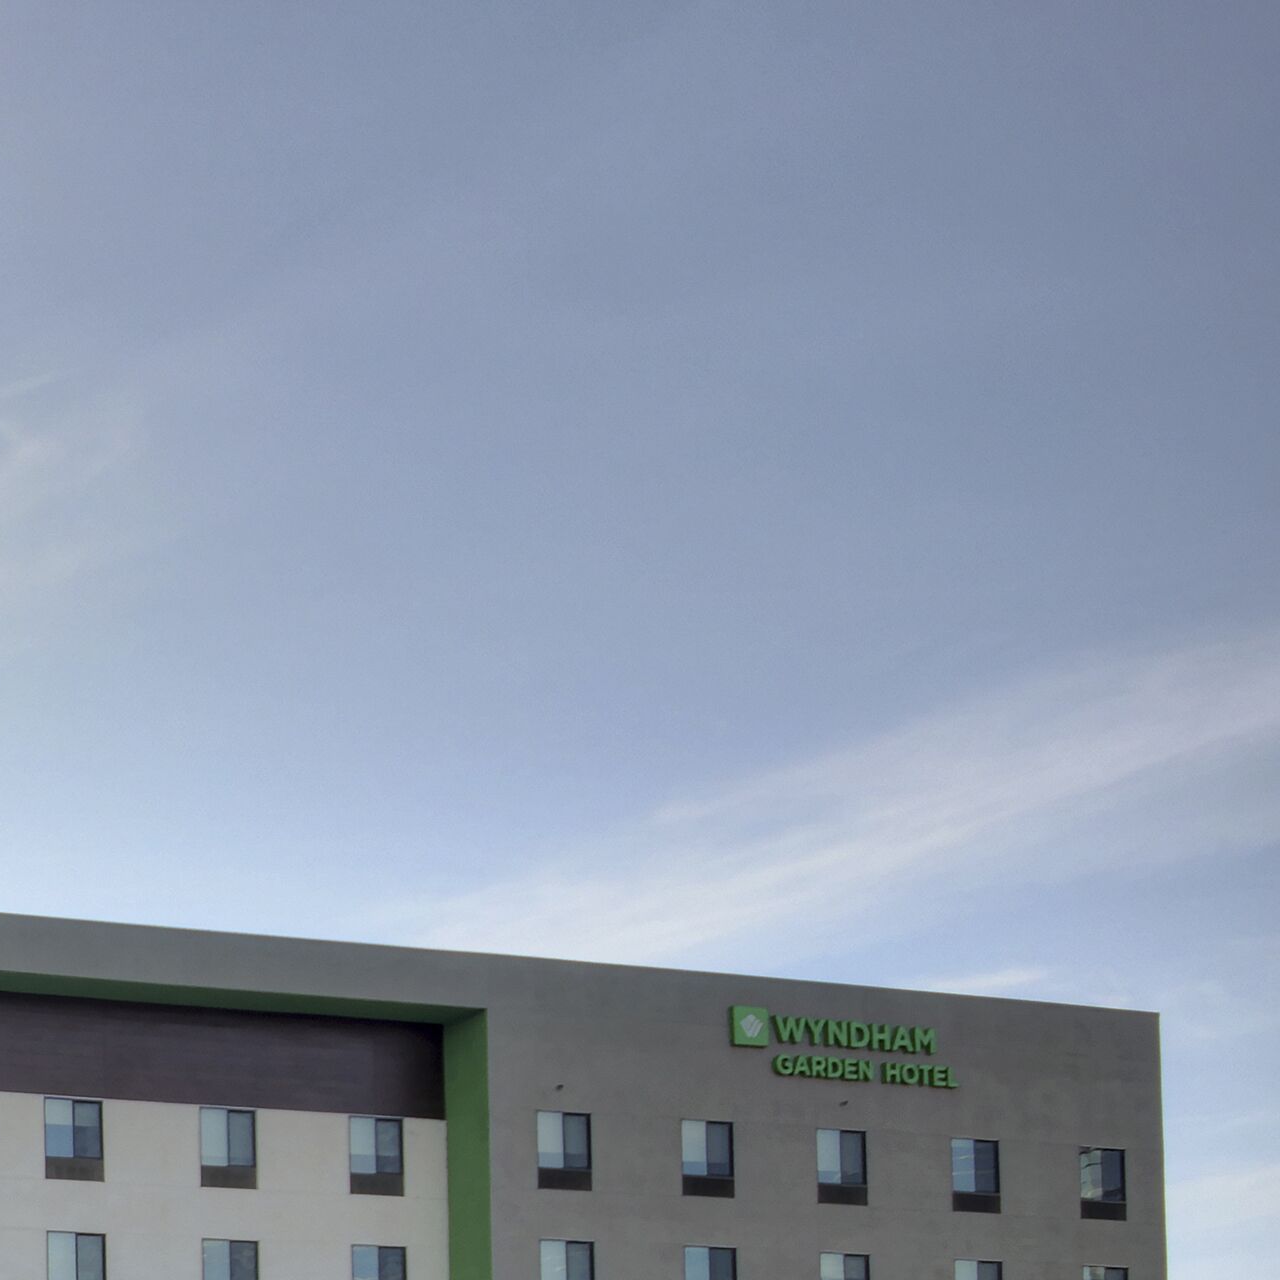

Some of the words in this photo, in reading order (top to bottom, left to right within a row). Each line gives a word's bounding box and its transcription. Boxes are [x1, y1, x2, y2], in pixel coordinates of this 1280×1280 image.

[772, 1014, 937, 1055] WYNDHAM
[773, 1054, 874, 1082] GARDEN
[881, 1062, 960, 1089] HOTEL
